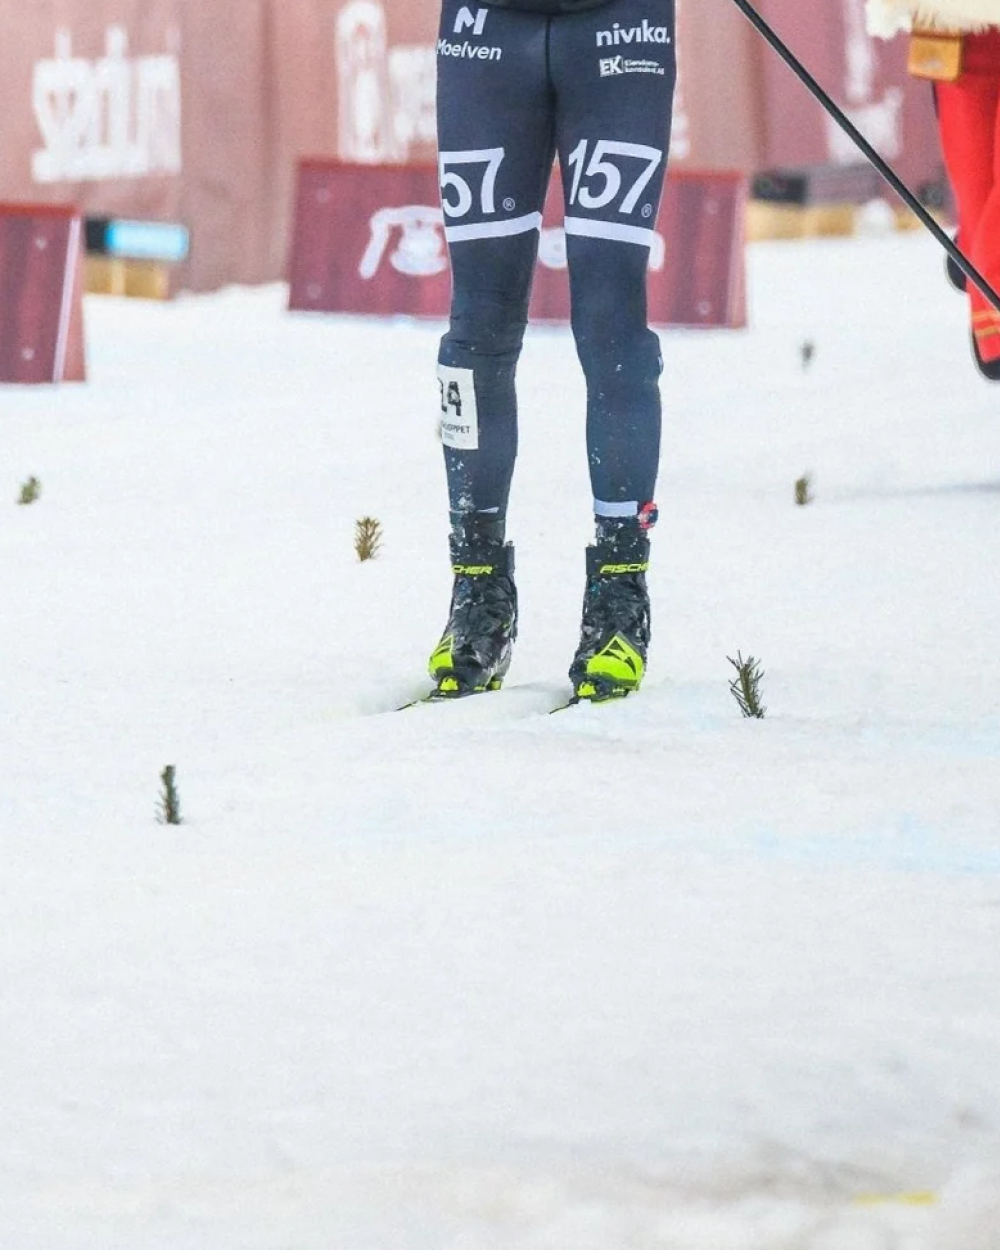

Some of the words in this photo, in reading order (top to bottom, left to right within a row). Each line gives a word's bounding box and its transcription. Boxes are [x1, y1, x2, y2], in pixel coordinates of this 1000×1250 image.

[437, 38, 502, 61] Moelven
[599, 55, 623, 77] EK
[568, 139, 662, 214] 157
